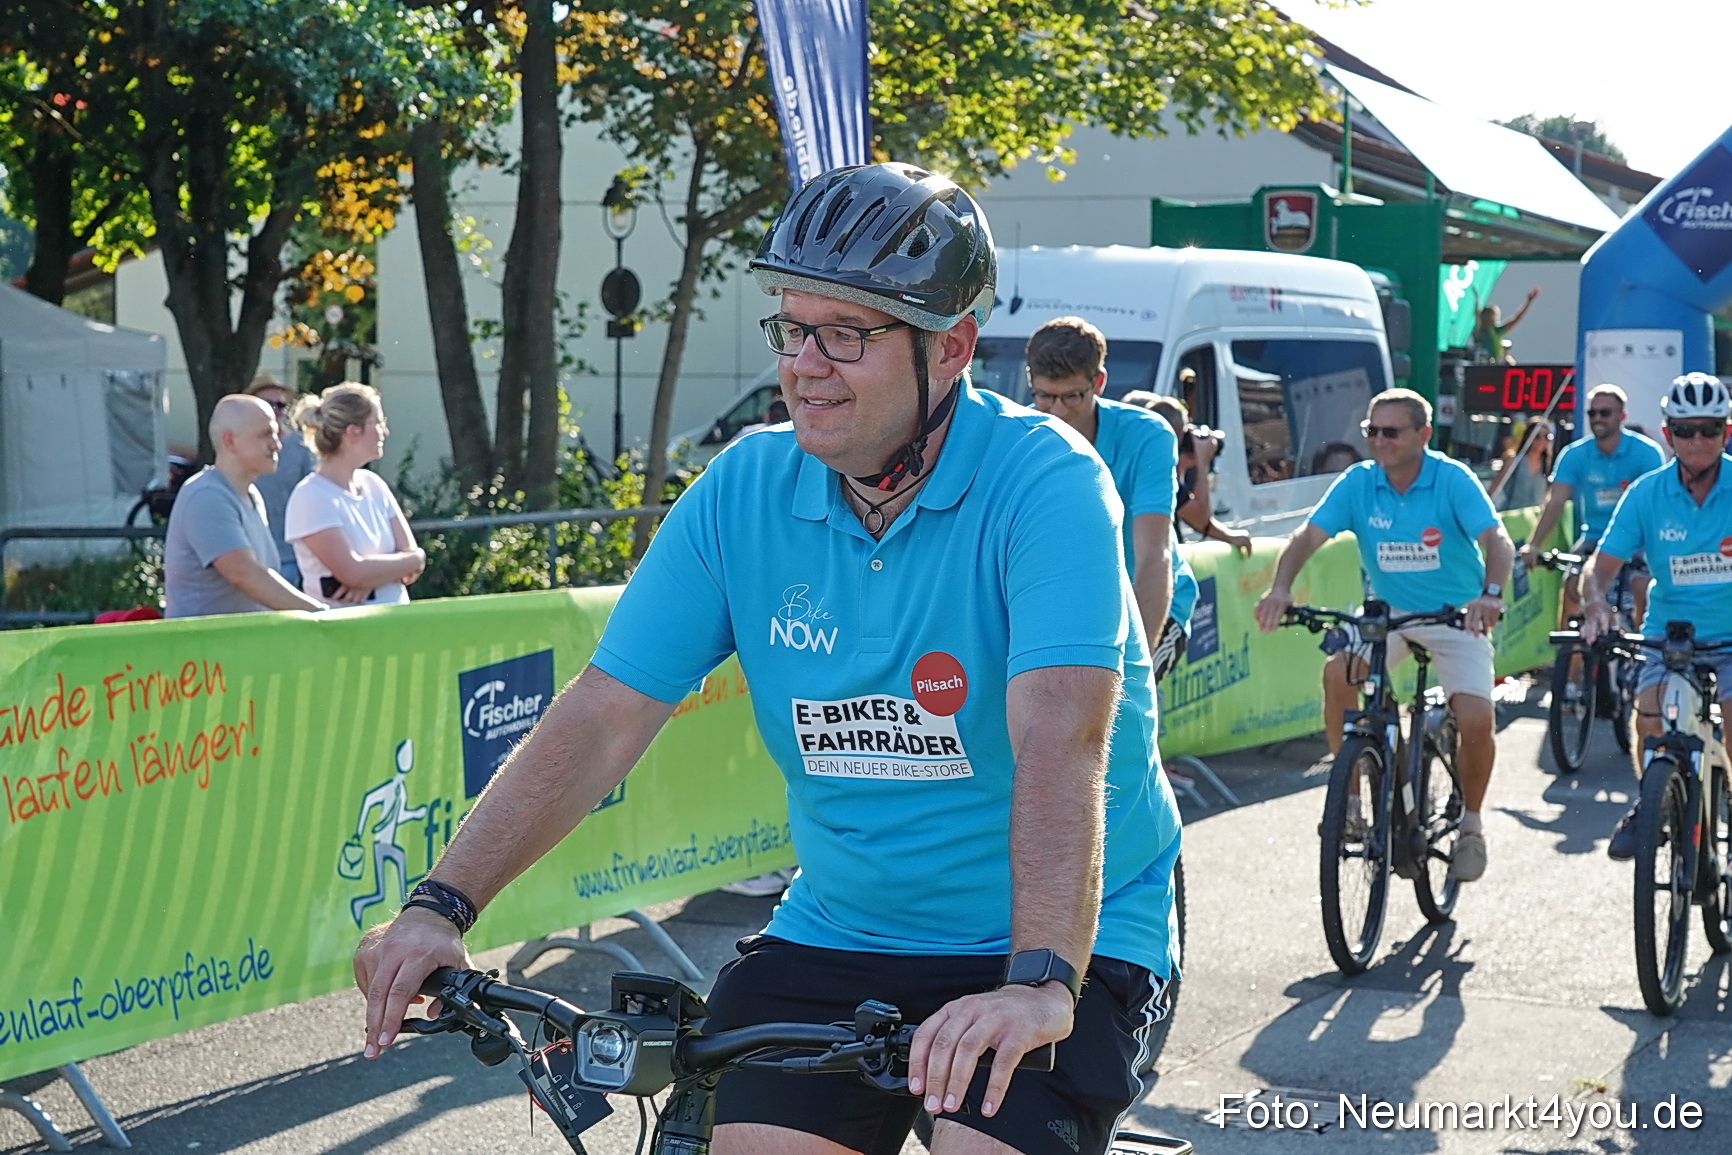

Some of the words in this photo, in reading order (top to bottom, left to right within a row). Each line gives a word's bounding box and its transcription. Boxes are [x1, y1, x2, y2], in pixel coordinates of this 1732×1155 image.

[777, 583, 834, 624] Bike
[769, 617, 839, 655] NOW
[102, 660, 227, 721] Firmen
[916, 674, 964, 694] Pilsach
[478, 693, 543, 730] Fischer
[795, 699, 899, 726] E-BIKES
[903, 703, 923, 726] &
[800, 724, 962, 756] FAHRRÄDER
[3, 746, 124, 824] laufen
[130, 698, 260, 789] länger!
[807, 759, 840, 774] DEIN
[843, 761, 889, 776] NEUER
[892, 762, 971, 778] BIKE-STORE
